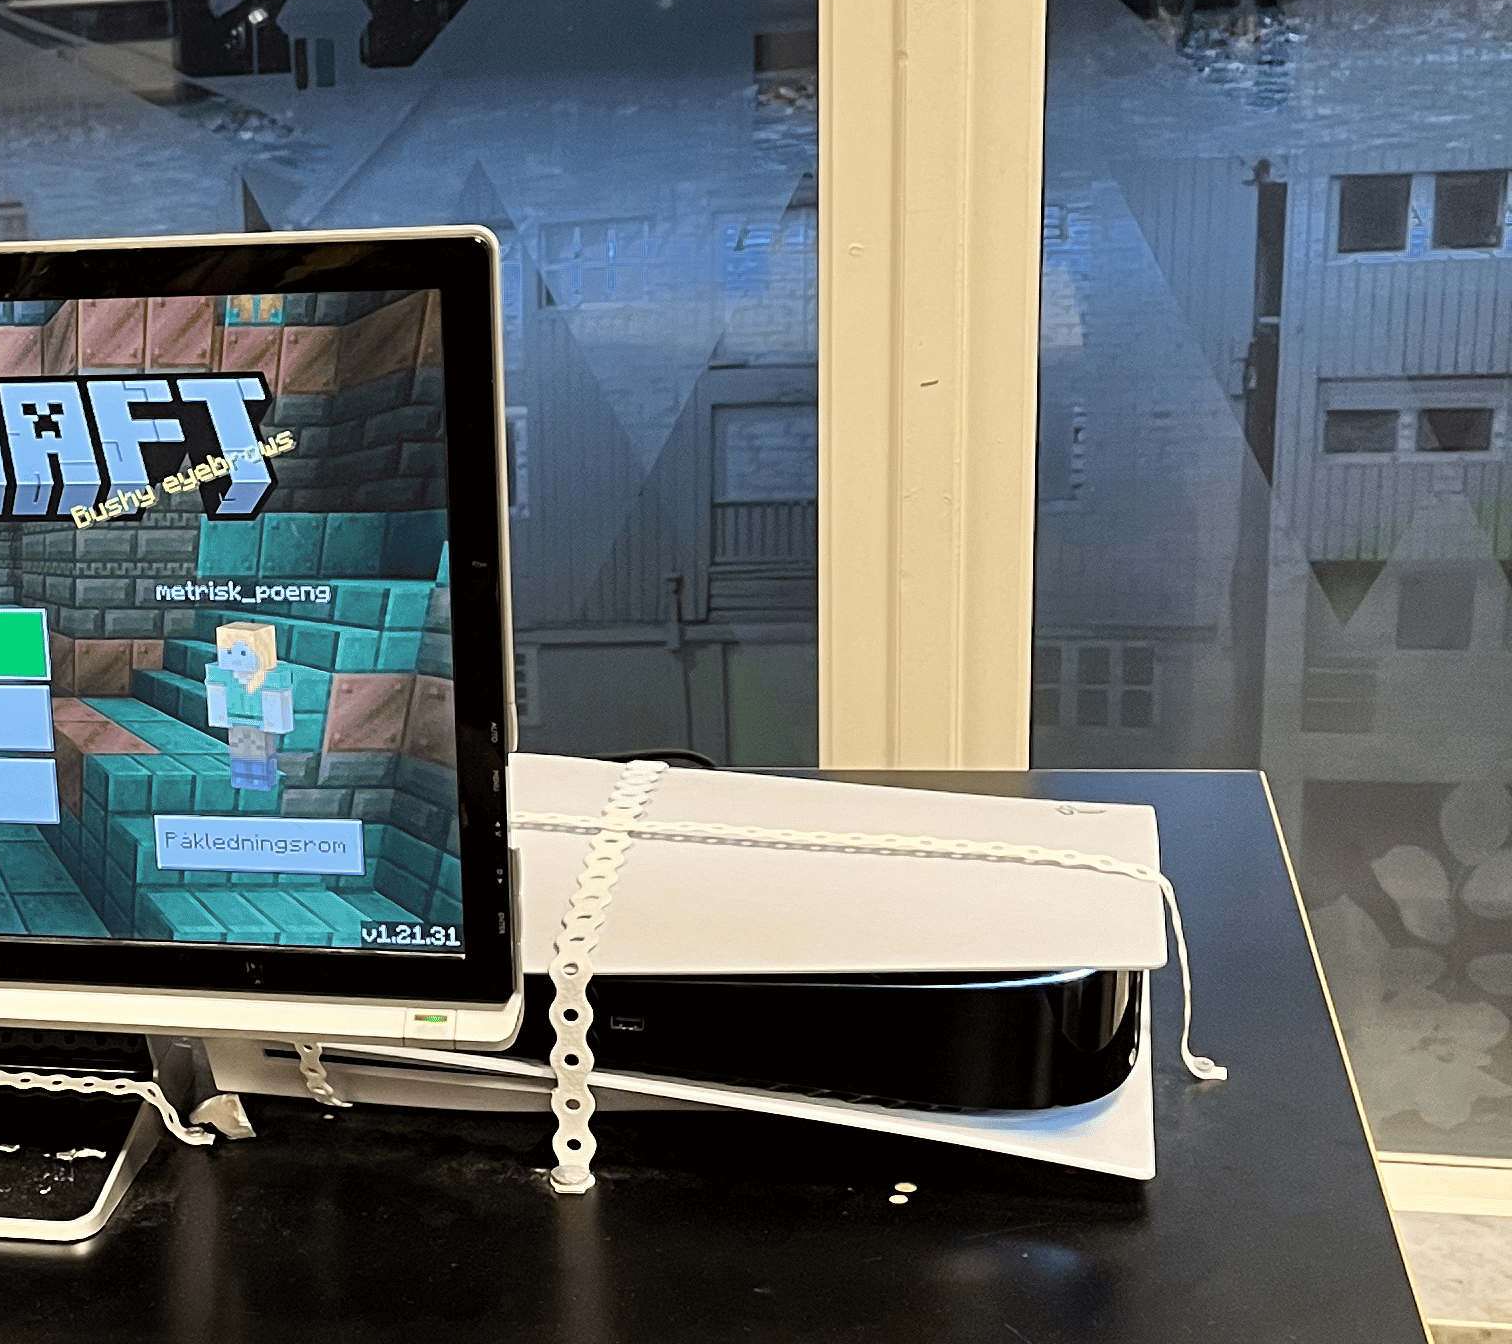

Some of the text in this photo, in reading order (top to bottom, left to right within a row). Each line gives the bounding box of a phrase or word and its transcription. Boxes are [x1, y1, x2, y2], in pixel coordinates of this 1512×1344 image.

[69, 430, 296, 529] Bushy eyebrows
[155, 580, 332, 604] metrisk_poeng
[164, 830, 347, 855] Påkledningsrom
[361, 923, 462, 947] v1.21.31
